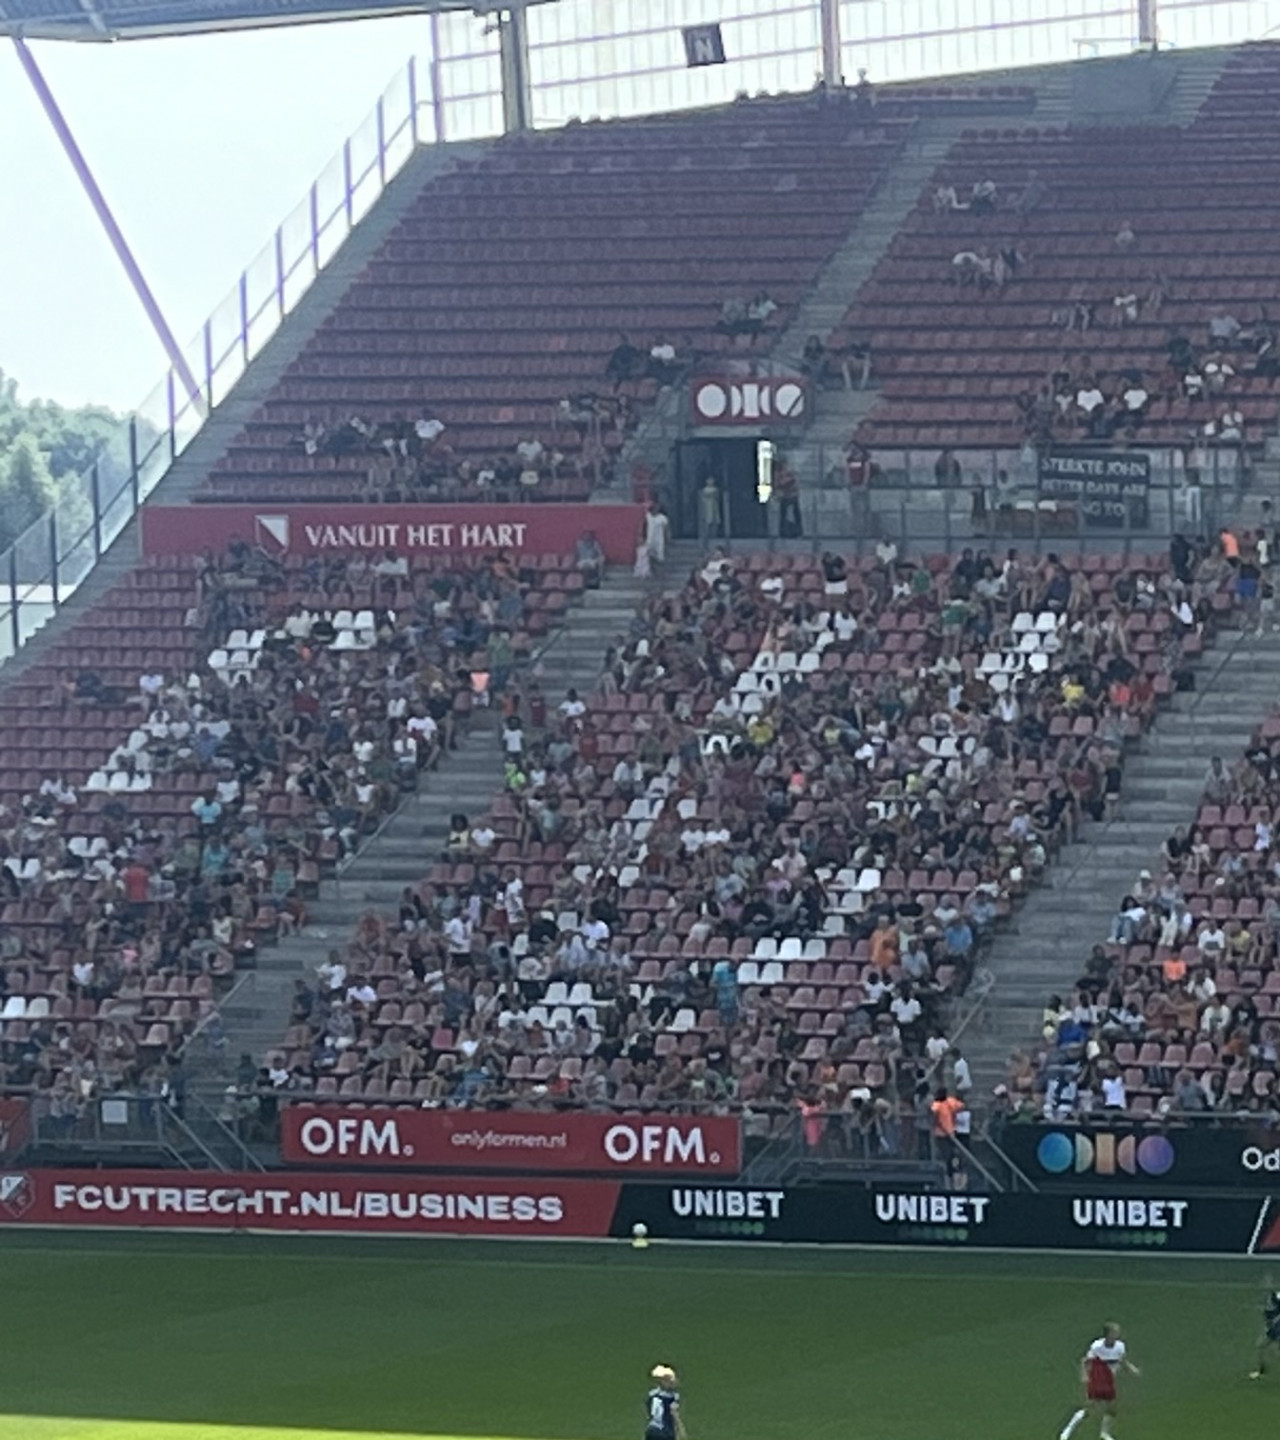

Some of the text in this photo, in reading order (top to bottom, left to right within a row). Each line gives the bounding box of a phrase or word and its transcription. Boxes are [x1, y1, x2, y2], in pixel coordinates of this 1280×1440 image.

[305, 523, 527, 547] VANUIT HET HART
[54, 1184, 563, 1221] FCUTRECHT.NL/BUSINESS
[672, 1189, 785, 1218] UNIBET
[875, 1194, 989, 1223] UNIBET
[1073, 1199, 1188, 1228] UNIBET
